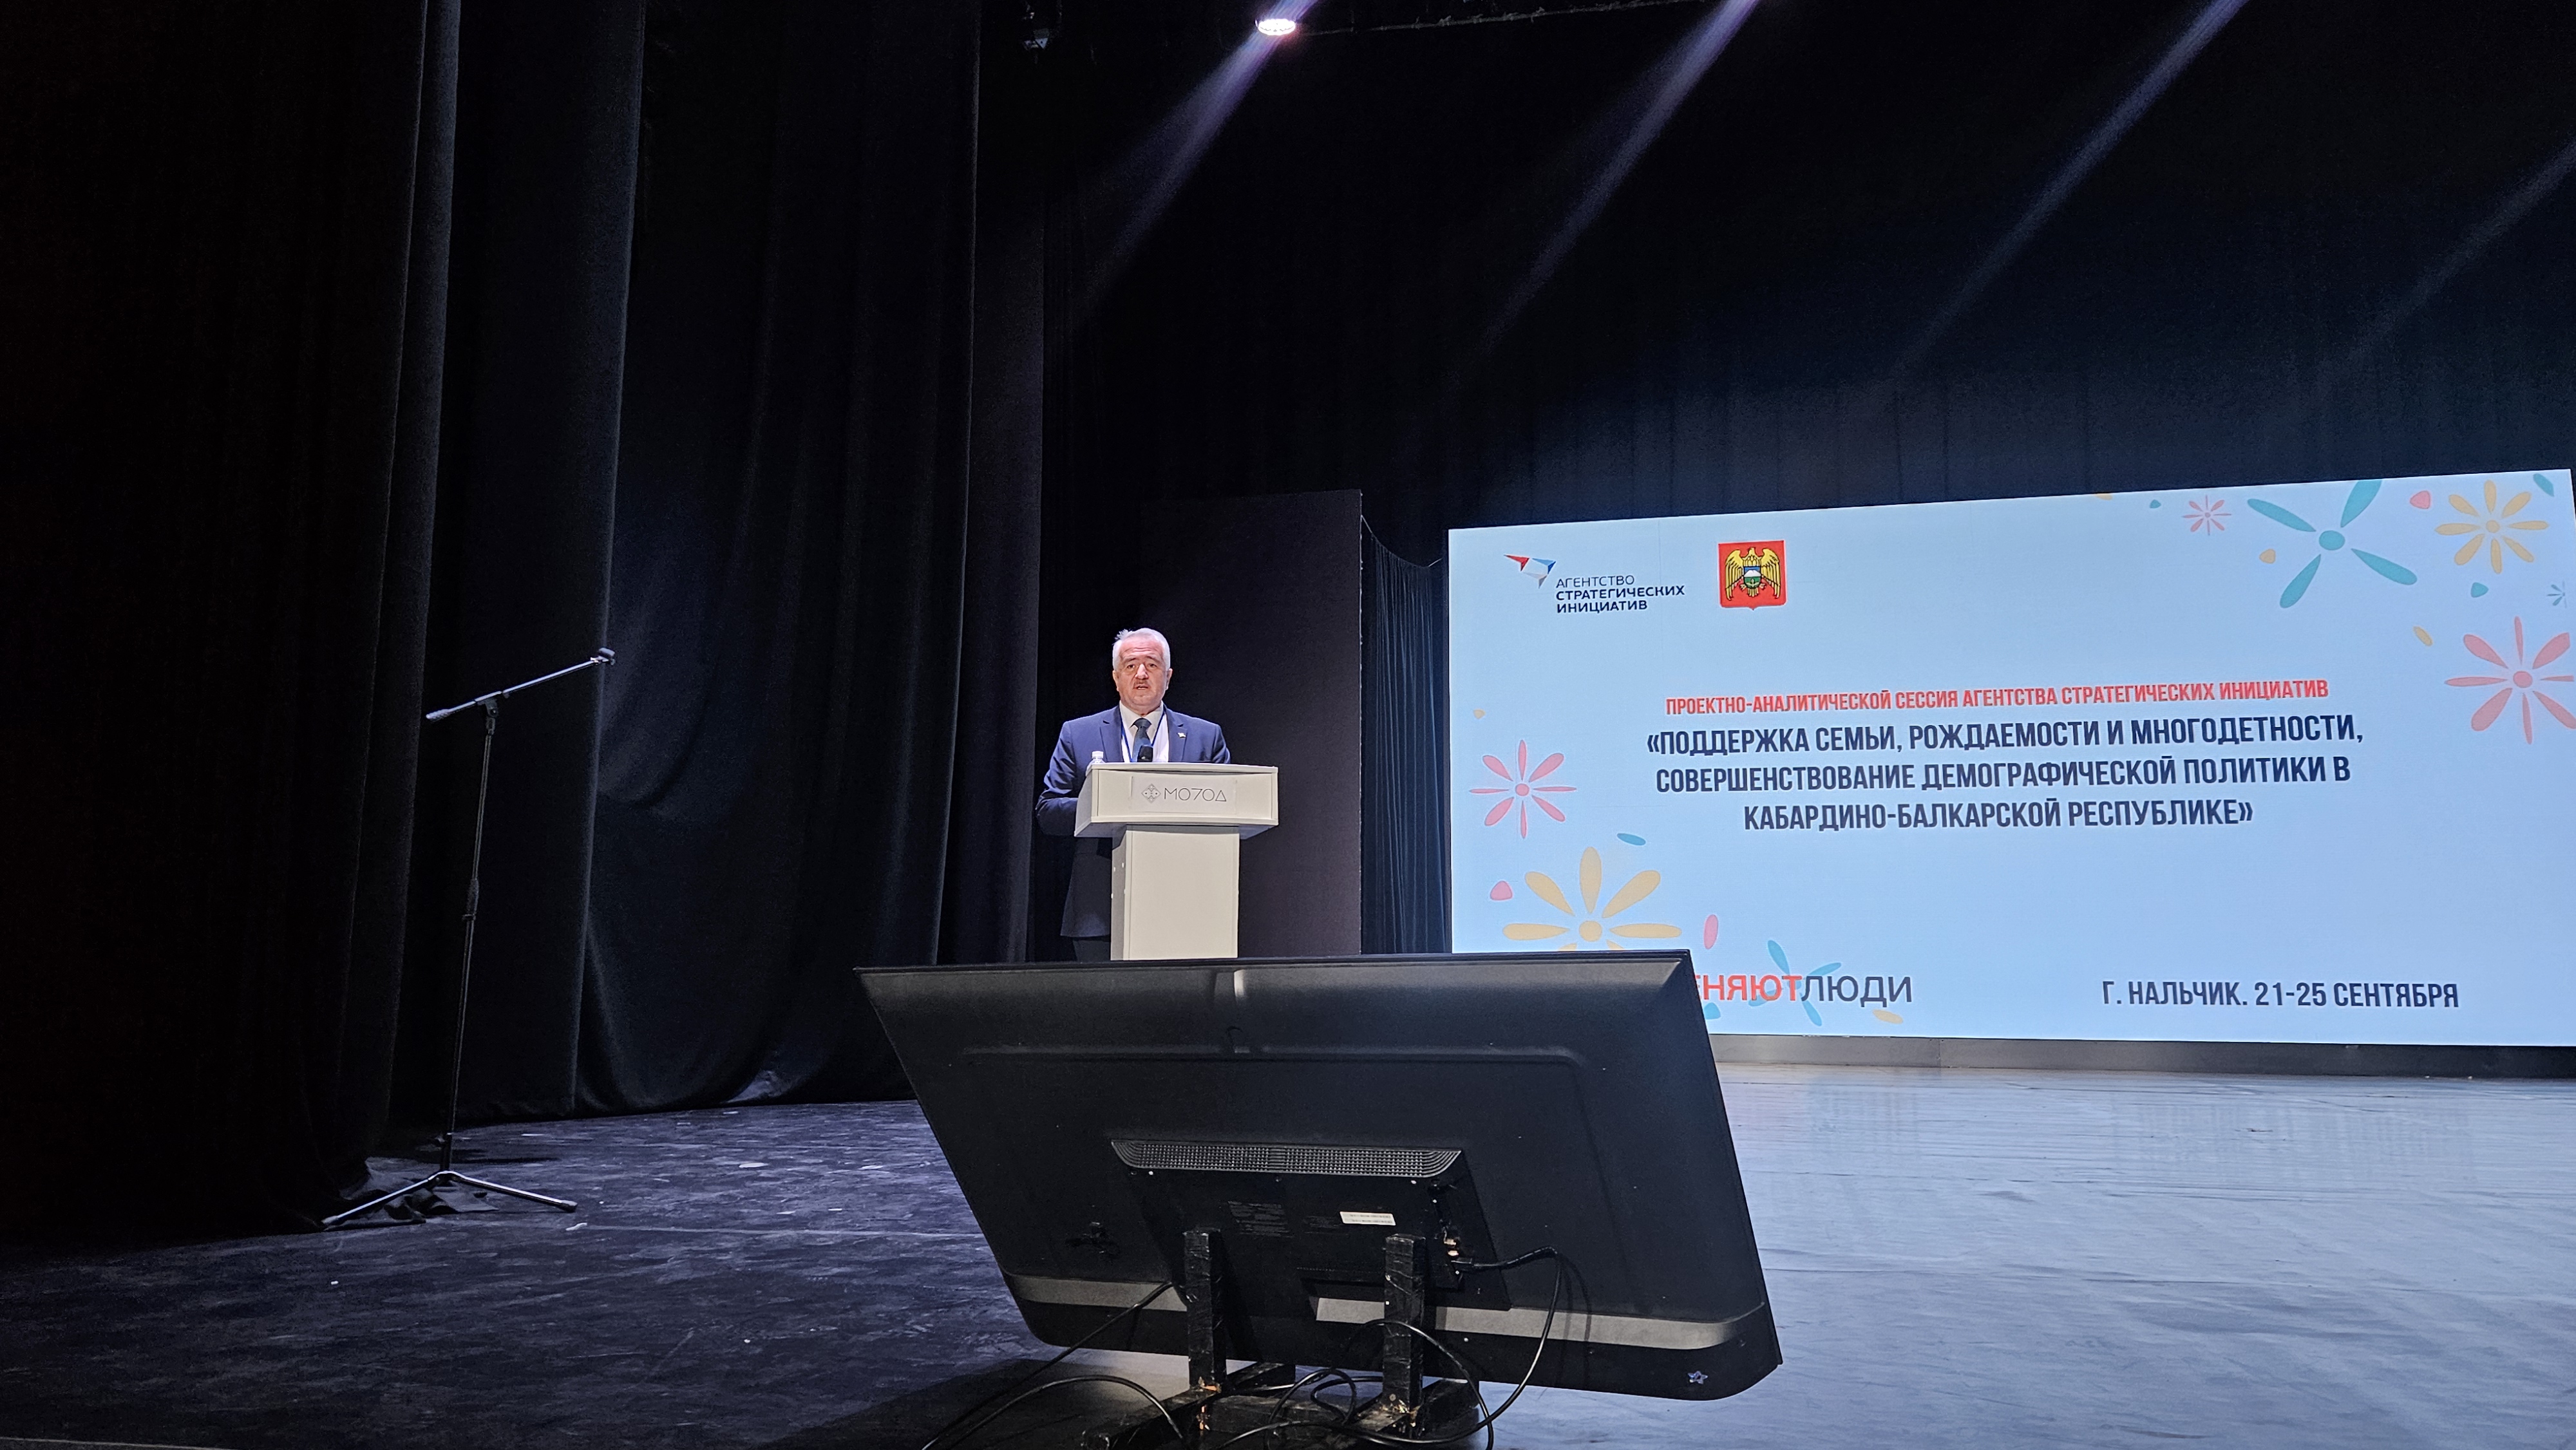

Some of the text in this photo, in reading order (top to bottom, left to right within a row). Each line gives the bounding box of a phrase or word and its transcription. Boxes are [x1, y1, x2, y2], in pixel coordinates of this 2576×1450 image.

[1556, 574, 1635, 588] АГЕНТСТВО
[1556, 585, 1685, 601] СТРАТЕГИЧЕСКИХ
[1557, 600, 1648, 614] ИНИЦИАТИВ
[1666, 679, 2329, 715] ПРОЕКТНО-АНАЛИТИЧЕСКОЙ СЕССИЯ АГЕНТСТВА СТРАТЕГИЧЕСКИХ ИНИЦИАТИВ
[1647, 715, 2363, 756] «ПОДДЕРЖКА СЕМЬИ, РОЖДАЕМОСТИ И МНОГОДЕТНОСТИ,
[1656, 755, 2351, 793] СОВЕРШЕНСТВОВАНИЕ ДЕМОГРАФИЧЕСКОЙ ПОЛИТИКИ В
[1744, 798, 2253, 831] КАБАРДИНО-БАЛКАРСКОЙ РЕСПУБЛИКЕ»
[1695, 974, 1913, 1008] НЯЮТЛЮДИ
[2102, 981, 2459, 1008] Г. НАЛЬЧИК. 21-25 СЕНТЯБРЯ
